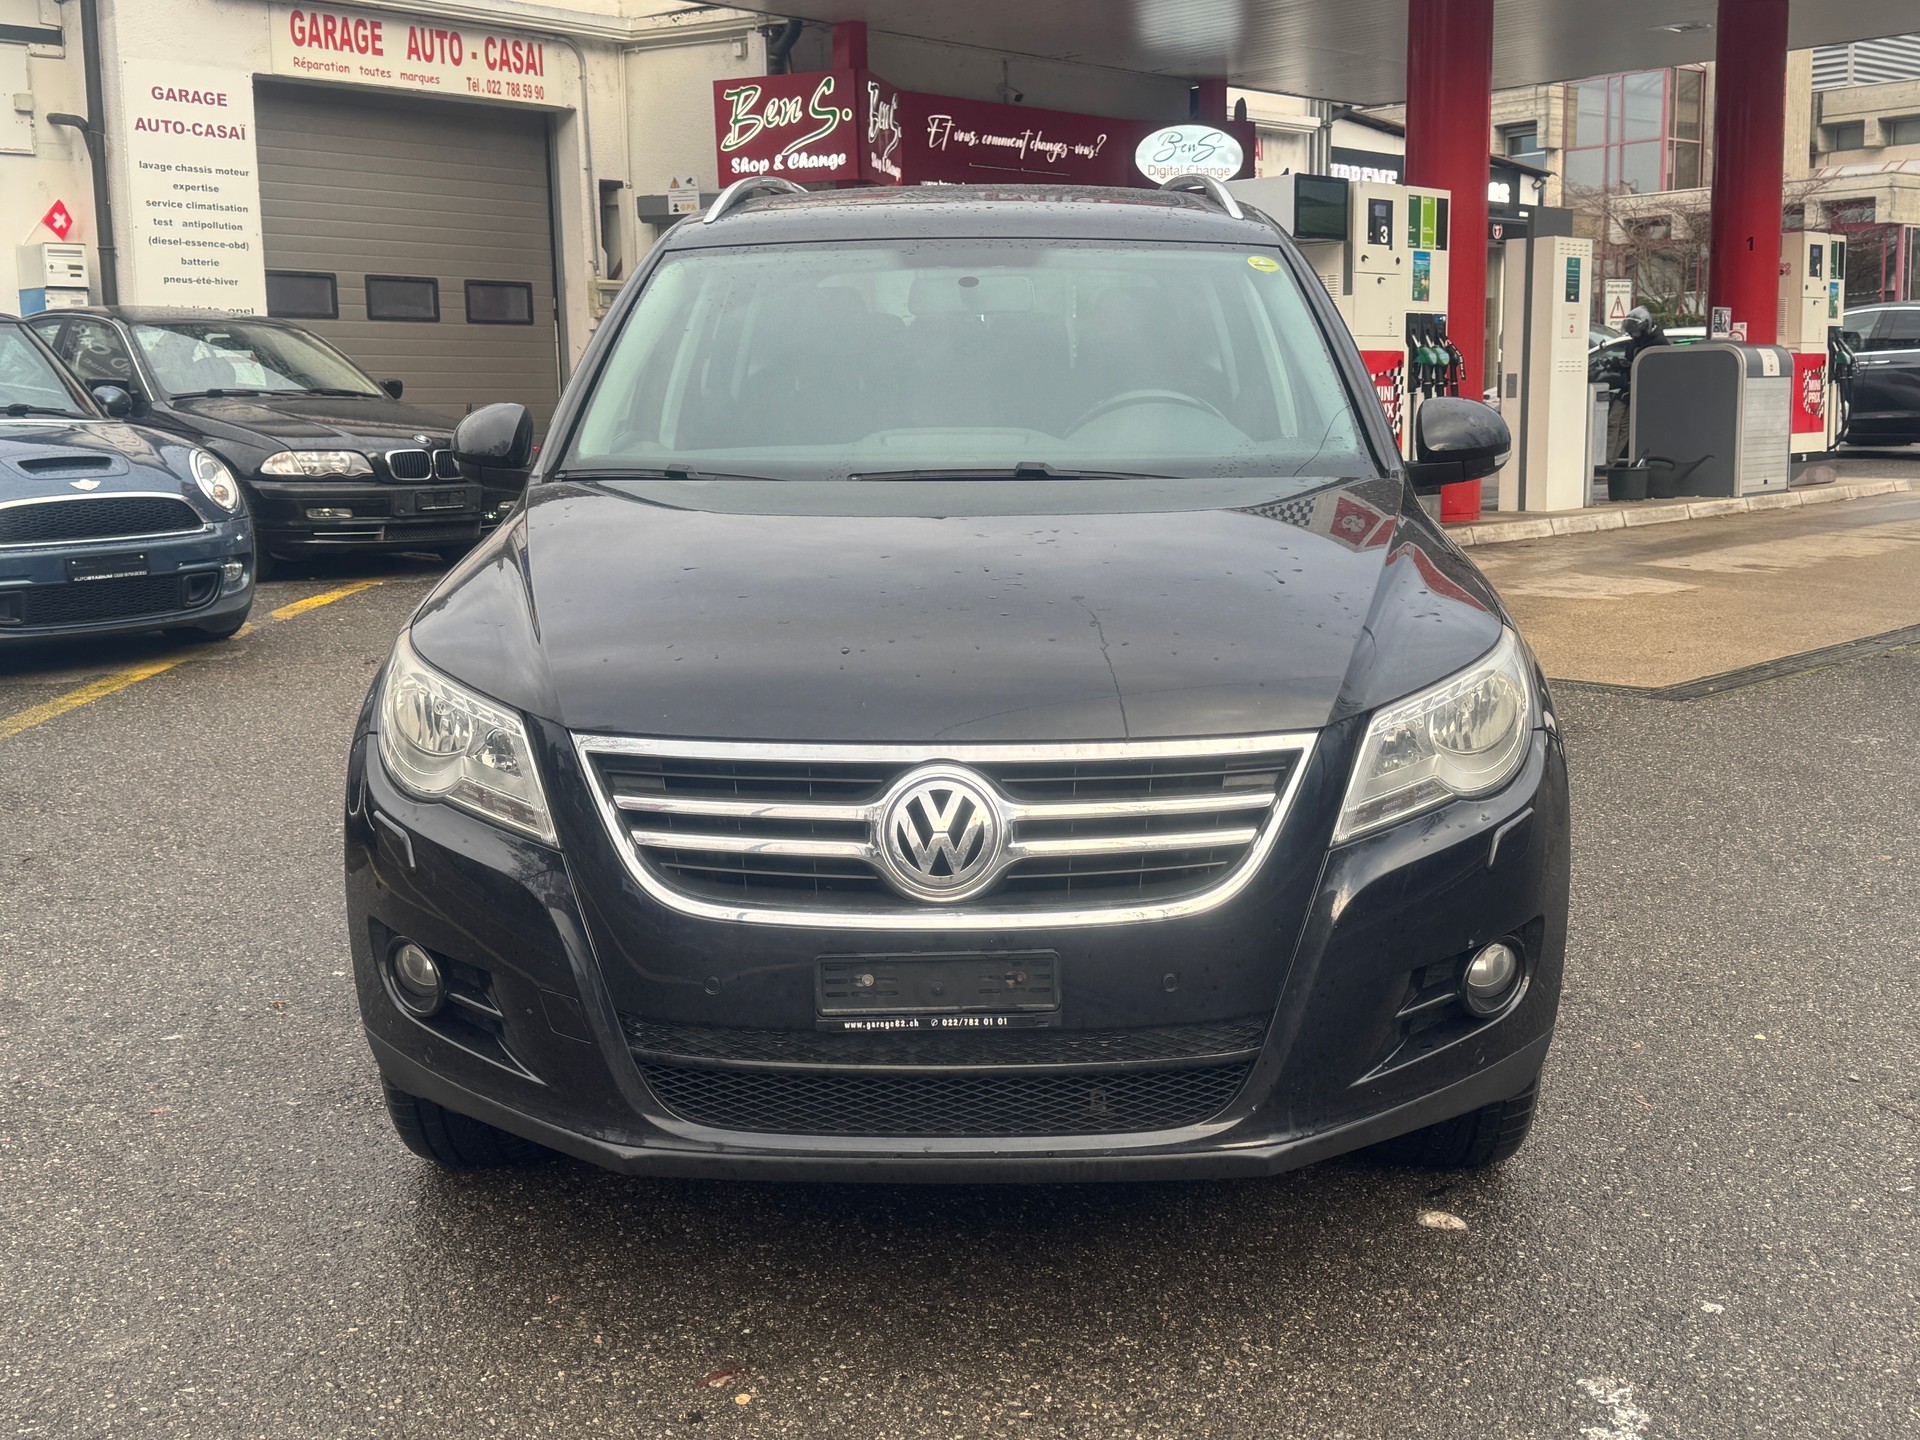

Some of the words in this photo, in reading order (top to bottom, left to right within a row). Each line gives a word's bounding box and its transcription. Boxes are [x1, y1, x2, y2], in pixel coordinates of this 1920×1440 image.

[289, 9, 384, 57] GARAGE
[406, 25, 463, 67] AUTO
[484, 36, 545, 77] CASAI
[293, 56, 350, 74] Réparation
[359, 65, 392, 79] toutes
[399, 71, 441, 85] marques
[151, 86, 228, 107] GARAGE
[486, 79, 502, 95] 022
[506, 82, 521, 97] 788
[523, 84, 532, 99] 59
[534, 85, 545, 100] 90
[720, 84, 803, 152] Ben
[134, 117, 246, 141] AUTO-CASAÏ
[927, 114, 956, 151] Et
[954, 129, 980, 147] vous,
[981, 129, 1034, 160] comment
[139, 160, 172, 172] lavage
[175, 164, 212, 174] chassis
[215, 167, 249, 177] moteur
[731, 157, 770, 175] Shop
[773, 154, 785, 171] &
[787, 151, 847, 171] Change
[1147, 164, 1183, 179] Digital
[173, 182, 219, 193] expertise
[146, 199, 183, 209] service
[185, 202, 248, 213] climatisation
[153, 218, 173, 227] test
[182, 220, 243, 231] antipollution
[1380, 225, 1389, 244] 3
[148, 236, 250, 251] (diesel-essence-obd)
[1746, 236, 1754, 251] 1
[181, 257, 220, 267] batterie
[1815, 263, 1820, 277] 1
[163, 276, 239, 286] pneus-été-hiver
[1808, 379, 1821, 391] MINI
[1808, 391, 1821, 404] PRIX
[890, 778, 996, 888] VW
[844, 1018, 919, 1030] www.garage82.ch
[942, 1018, 980, 1027] 022/782
[983, 1018, 993, 1026] 01
[997, 1017, 1008, 1026] 01
